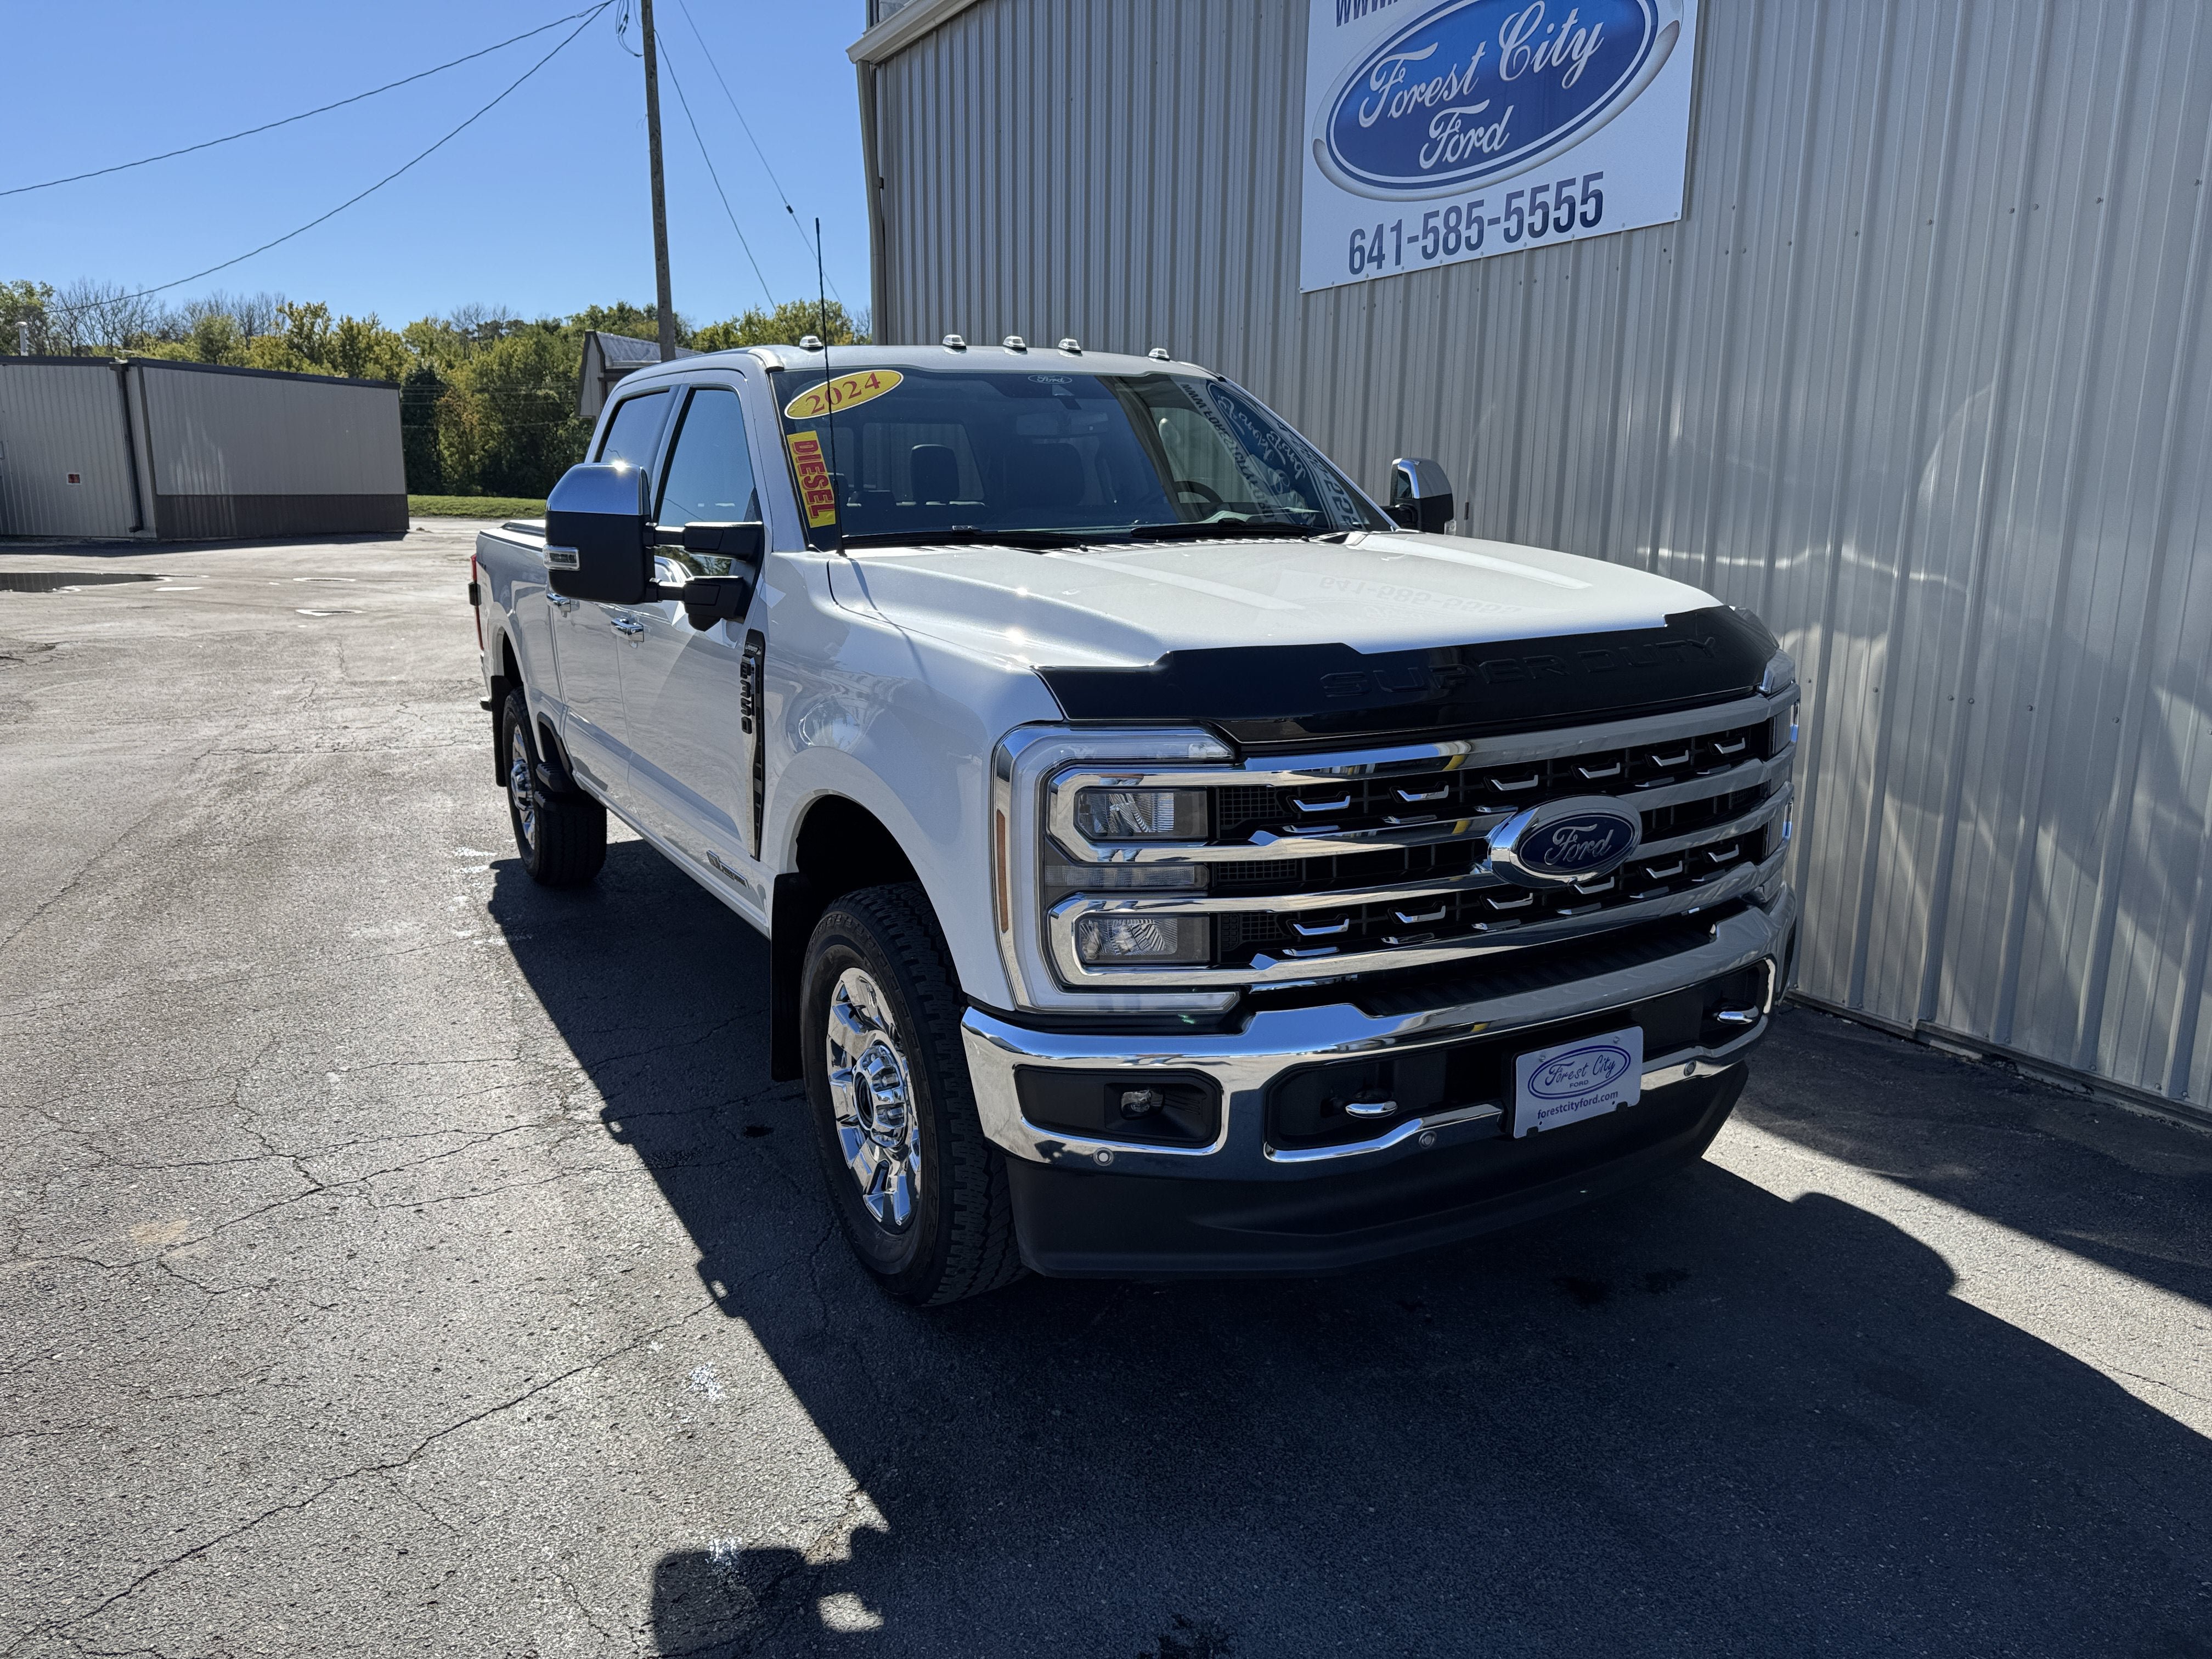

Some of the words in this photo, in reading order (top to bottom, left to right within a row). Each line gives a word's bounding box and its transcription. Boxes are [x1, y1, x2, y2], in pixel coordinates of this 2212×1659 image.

[1358, 42, 1487, 128] Forest
[1498, 0, 1604, 89] City
[1419, 99, 1514, 170] Ford
[1349, 172, 1604, 275] 641-585-5555
[805, 372, 881, 415] 2024
[792, 439, 836, 519] DIESEL
[1319, 654, 1571, 697] SUPER
[1578, 635, 1716, 674] DUTY
[1544, 823, 1614, 866] Ford
[1545, 1061, 1589, 1086] Forest
[1592, 1054, 1616, 1079] City
[1569, 1079, 1589, 1088] FORD
[1537, 1090, 1618, 1119] forestcityford.com
